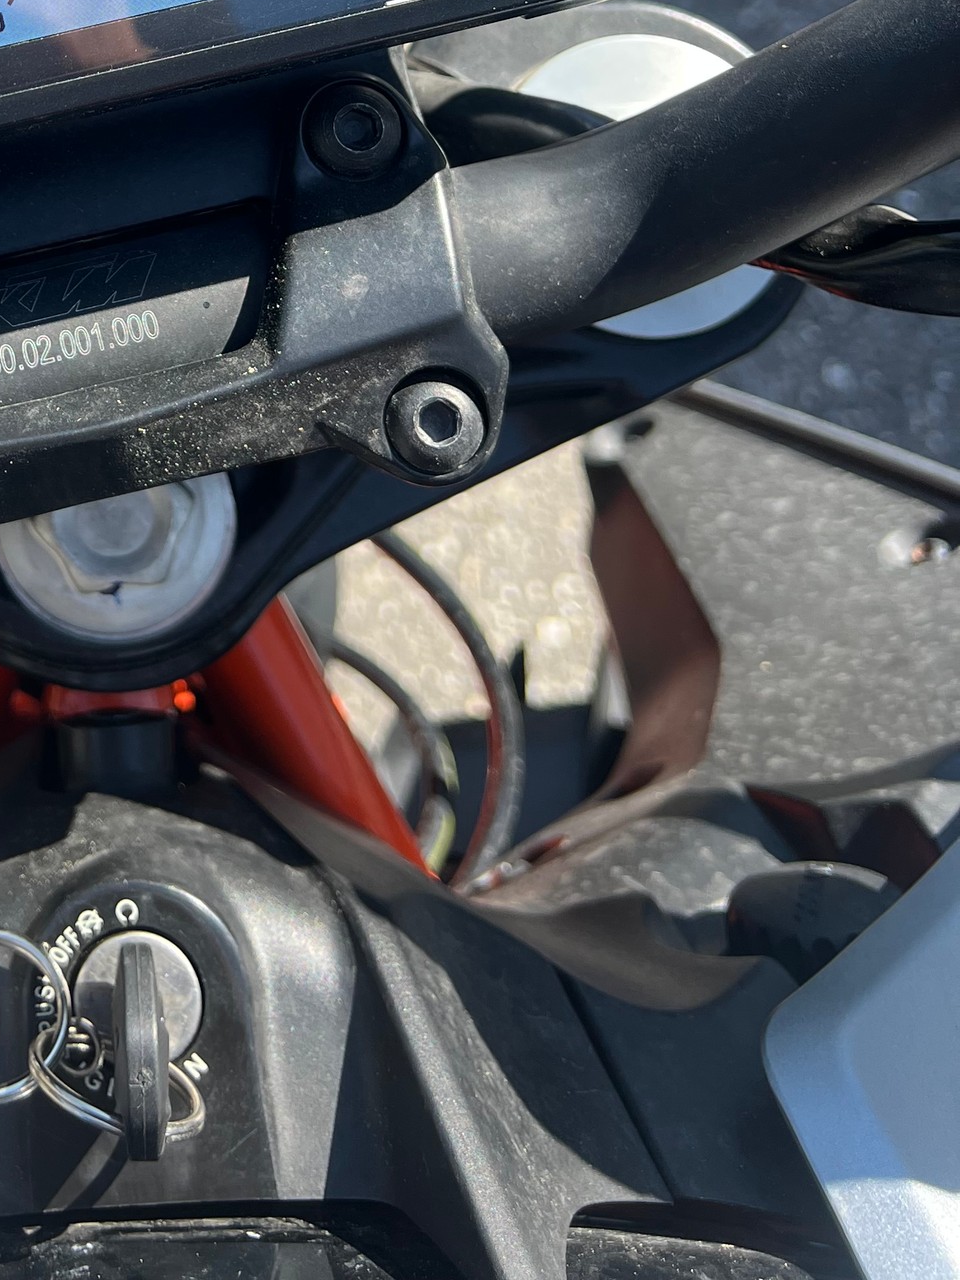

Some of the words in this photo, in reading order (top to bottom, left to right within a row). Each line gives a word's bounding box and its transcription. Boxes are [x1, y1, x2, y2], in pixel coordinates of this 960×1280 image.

[48, 925, 81, 967] OFF
[35, 971, 56, 1032] PUS
[183, 1053, 209, 1081] N
